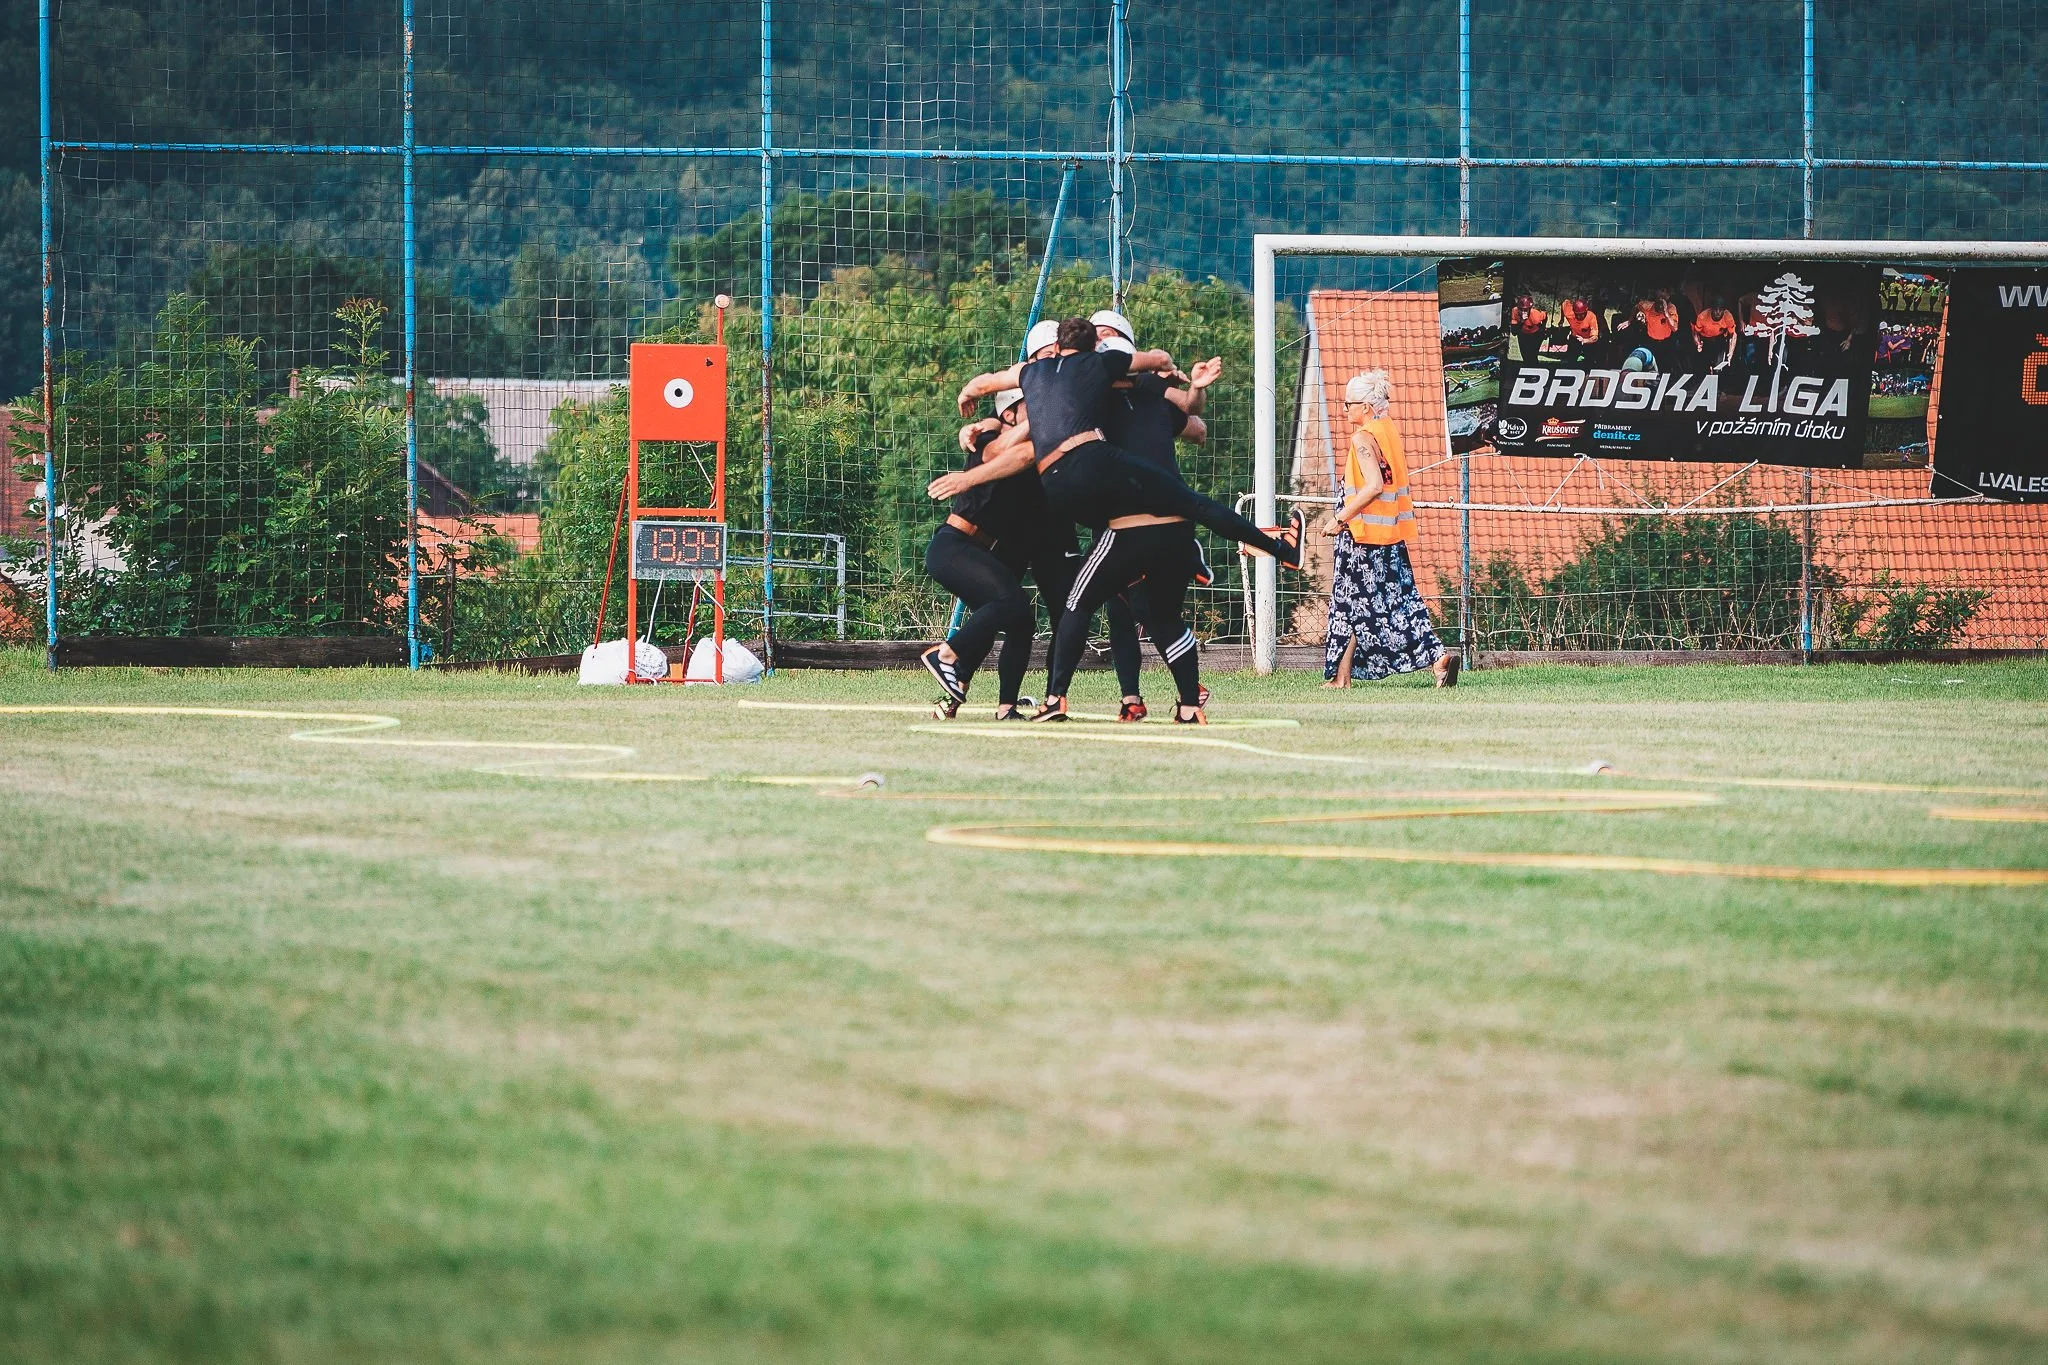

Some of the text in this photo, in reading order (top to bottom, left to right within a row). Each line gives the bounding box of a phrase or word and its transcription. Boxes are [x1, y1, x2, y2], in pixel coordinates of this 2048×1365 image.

[1508, 367, 1849, 417] BRDSKA LIGA
[1593, 430, 1641, 441] deník.cz
[1696, 416, 1846, 440] v požárním útoku
